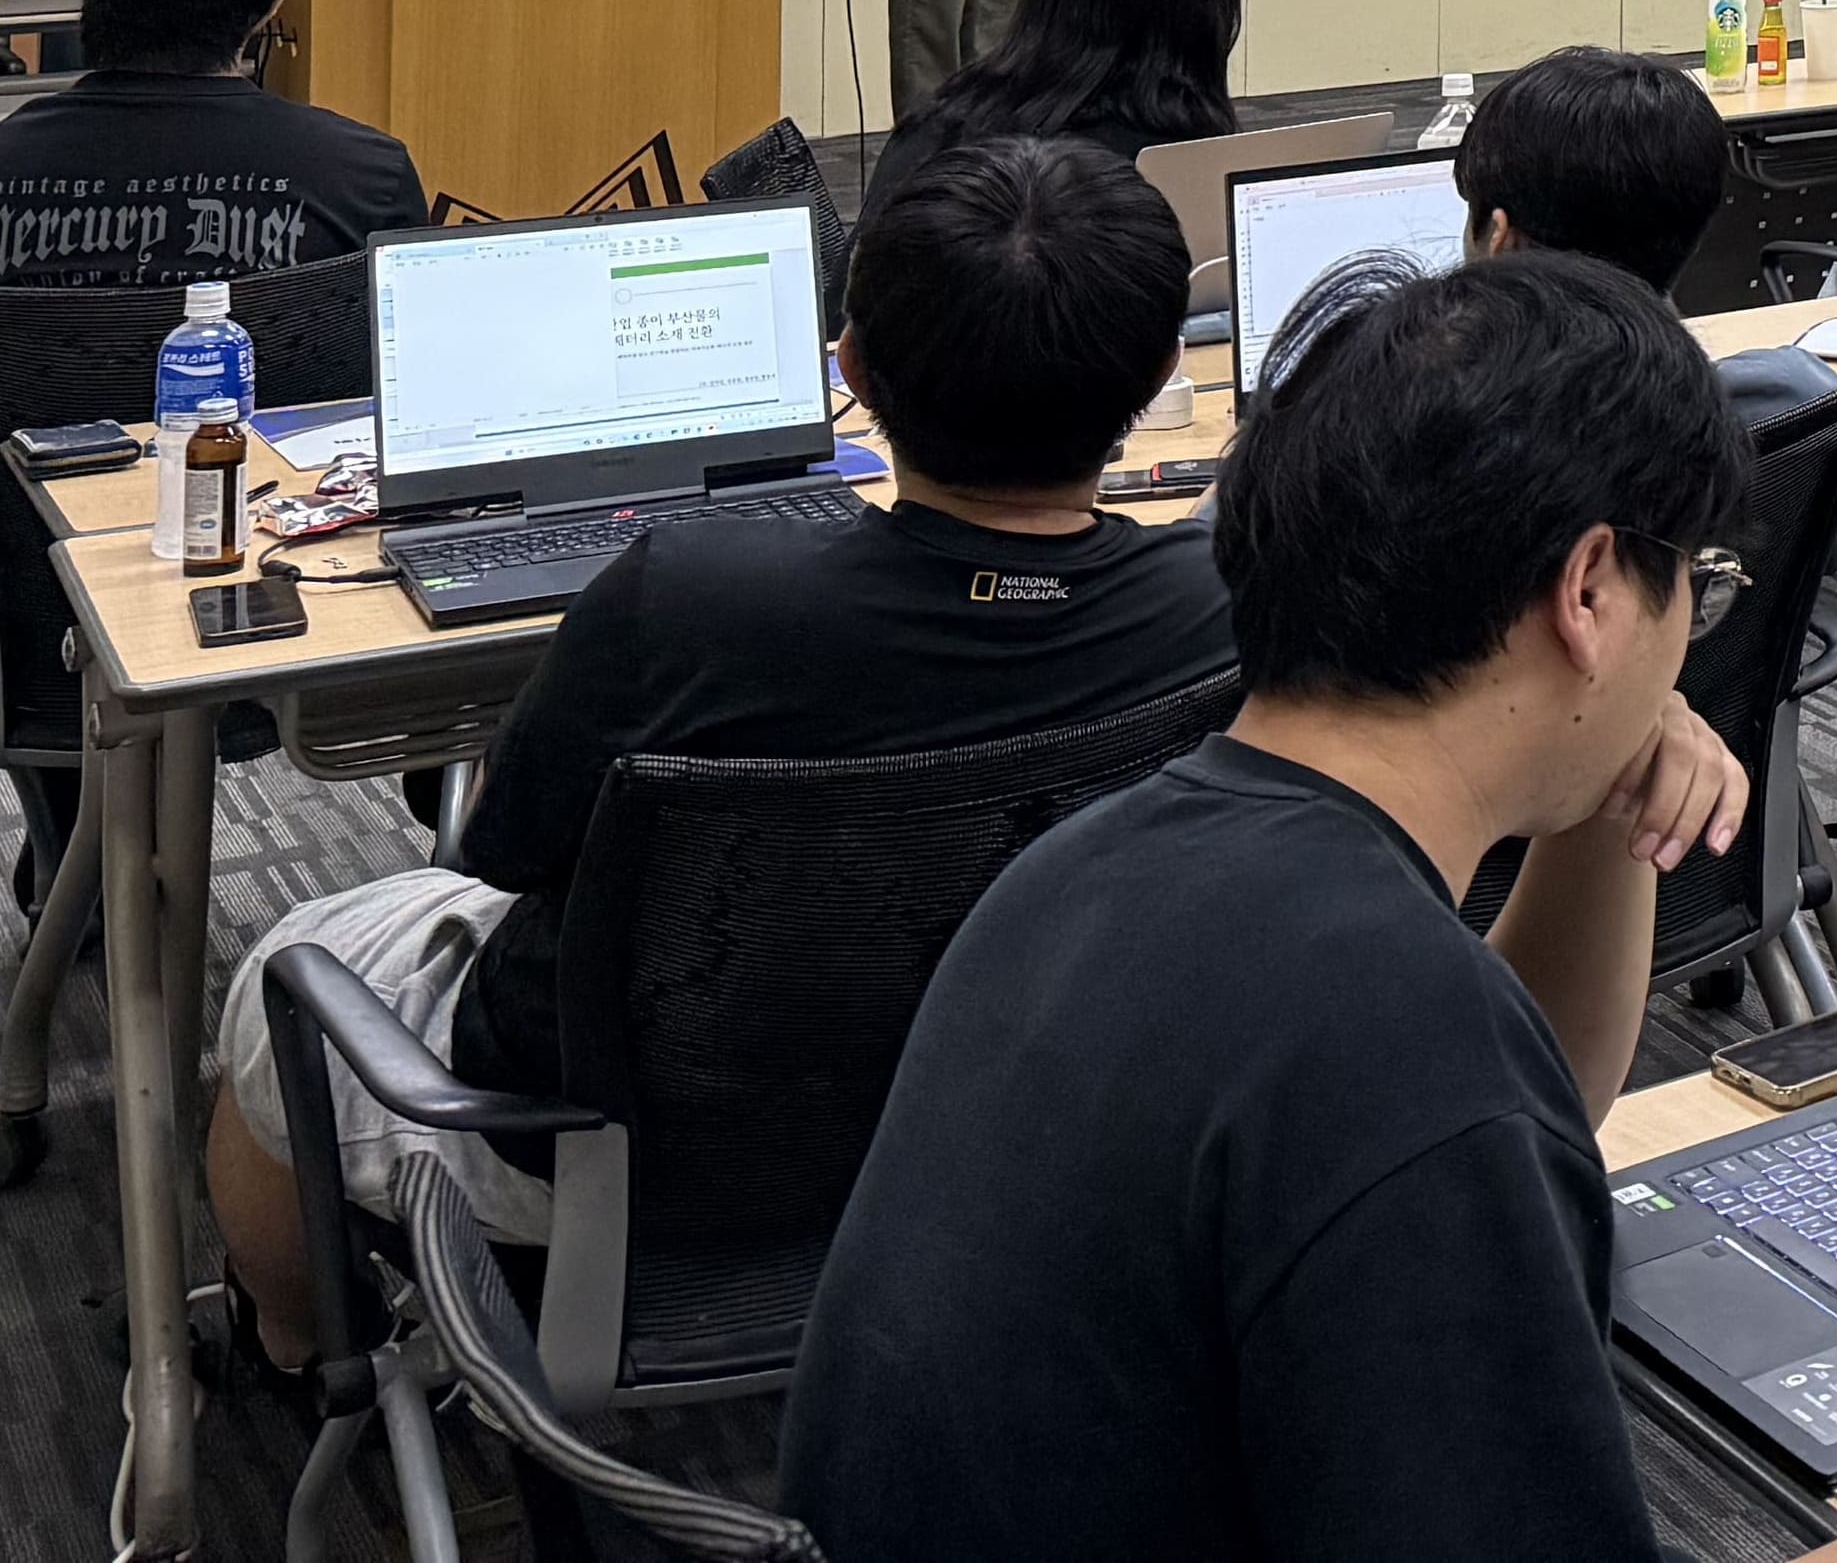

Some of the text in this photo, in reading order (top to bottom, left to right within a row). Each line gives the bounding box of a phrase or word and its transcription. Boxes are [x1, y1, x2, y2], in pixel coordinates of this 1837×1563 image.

[0, 171, 290, 198] intage aesthetics
[184, 197, 306, 270] Dust
[1000, 575, 1060, 589] NATIONAL
